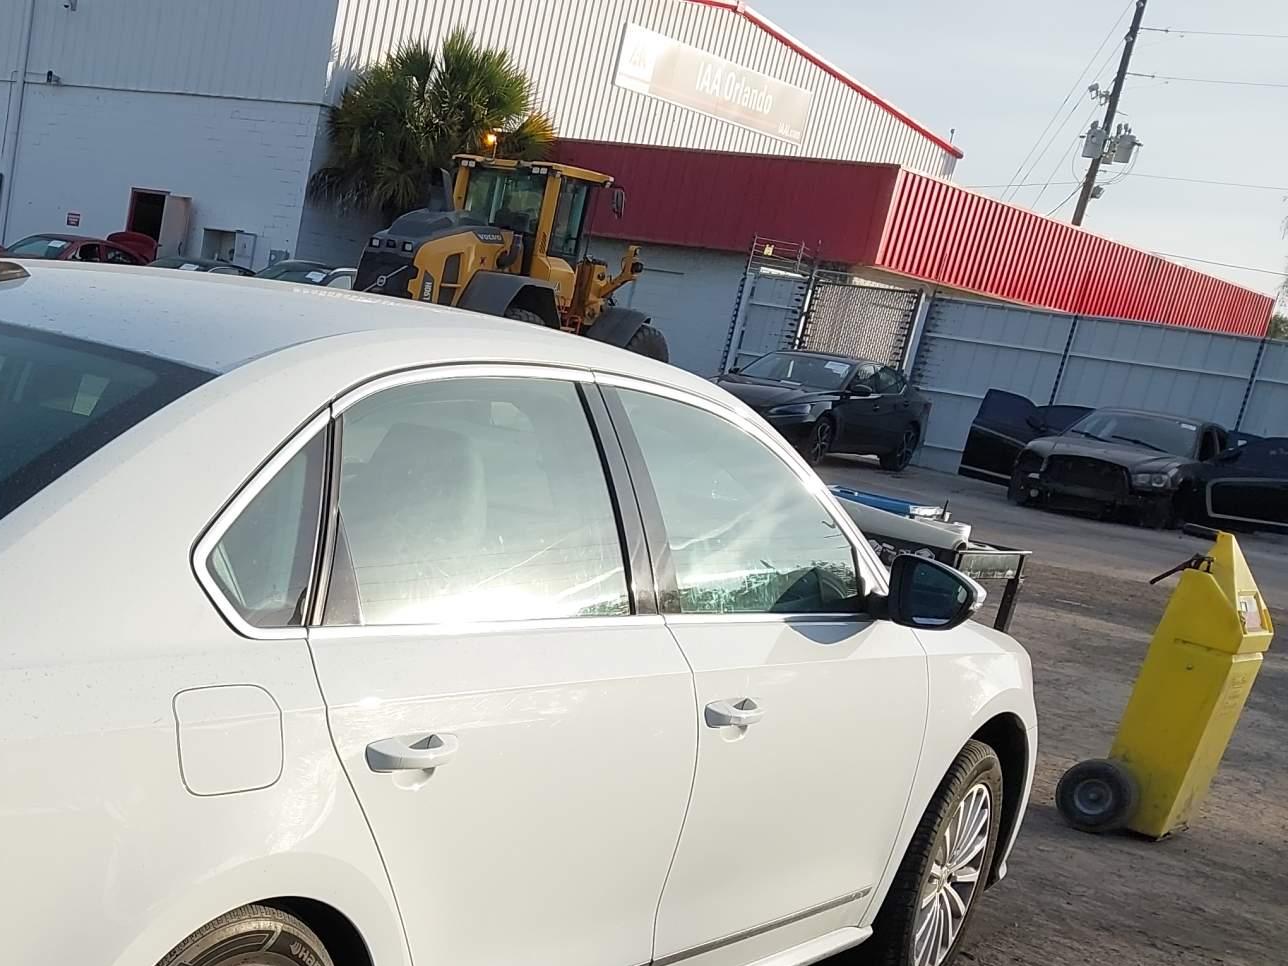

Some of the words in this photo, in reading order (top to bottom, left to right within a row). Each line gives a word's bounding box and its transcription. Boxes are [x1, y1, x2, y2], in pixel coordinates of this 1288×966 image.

[695, 61, 722, 98] IAA
[724, 72, 774, 115] Orlando
[479, 233, 502, 241] VOLVO
